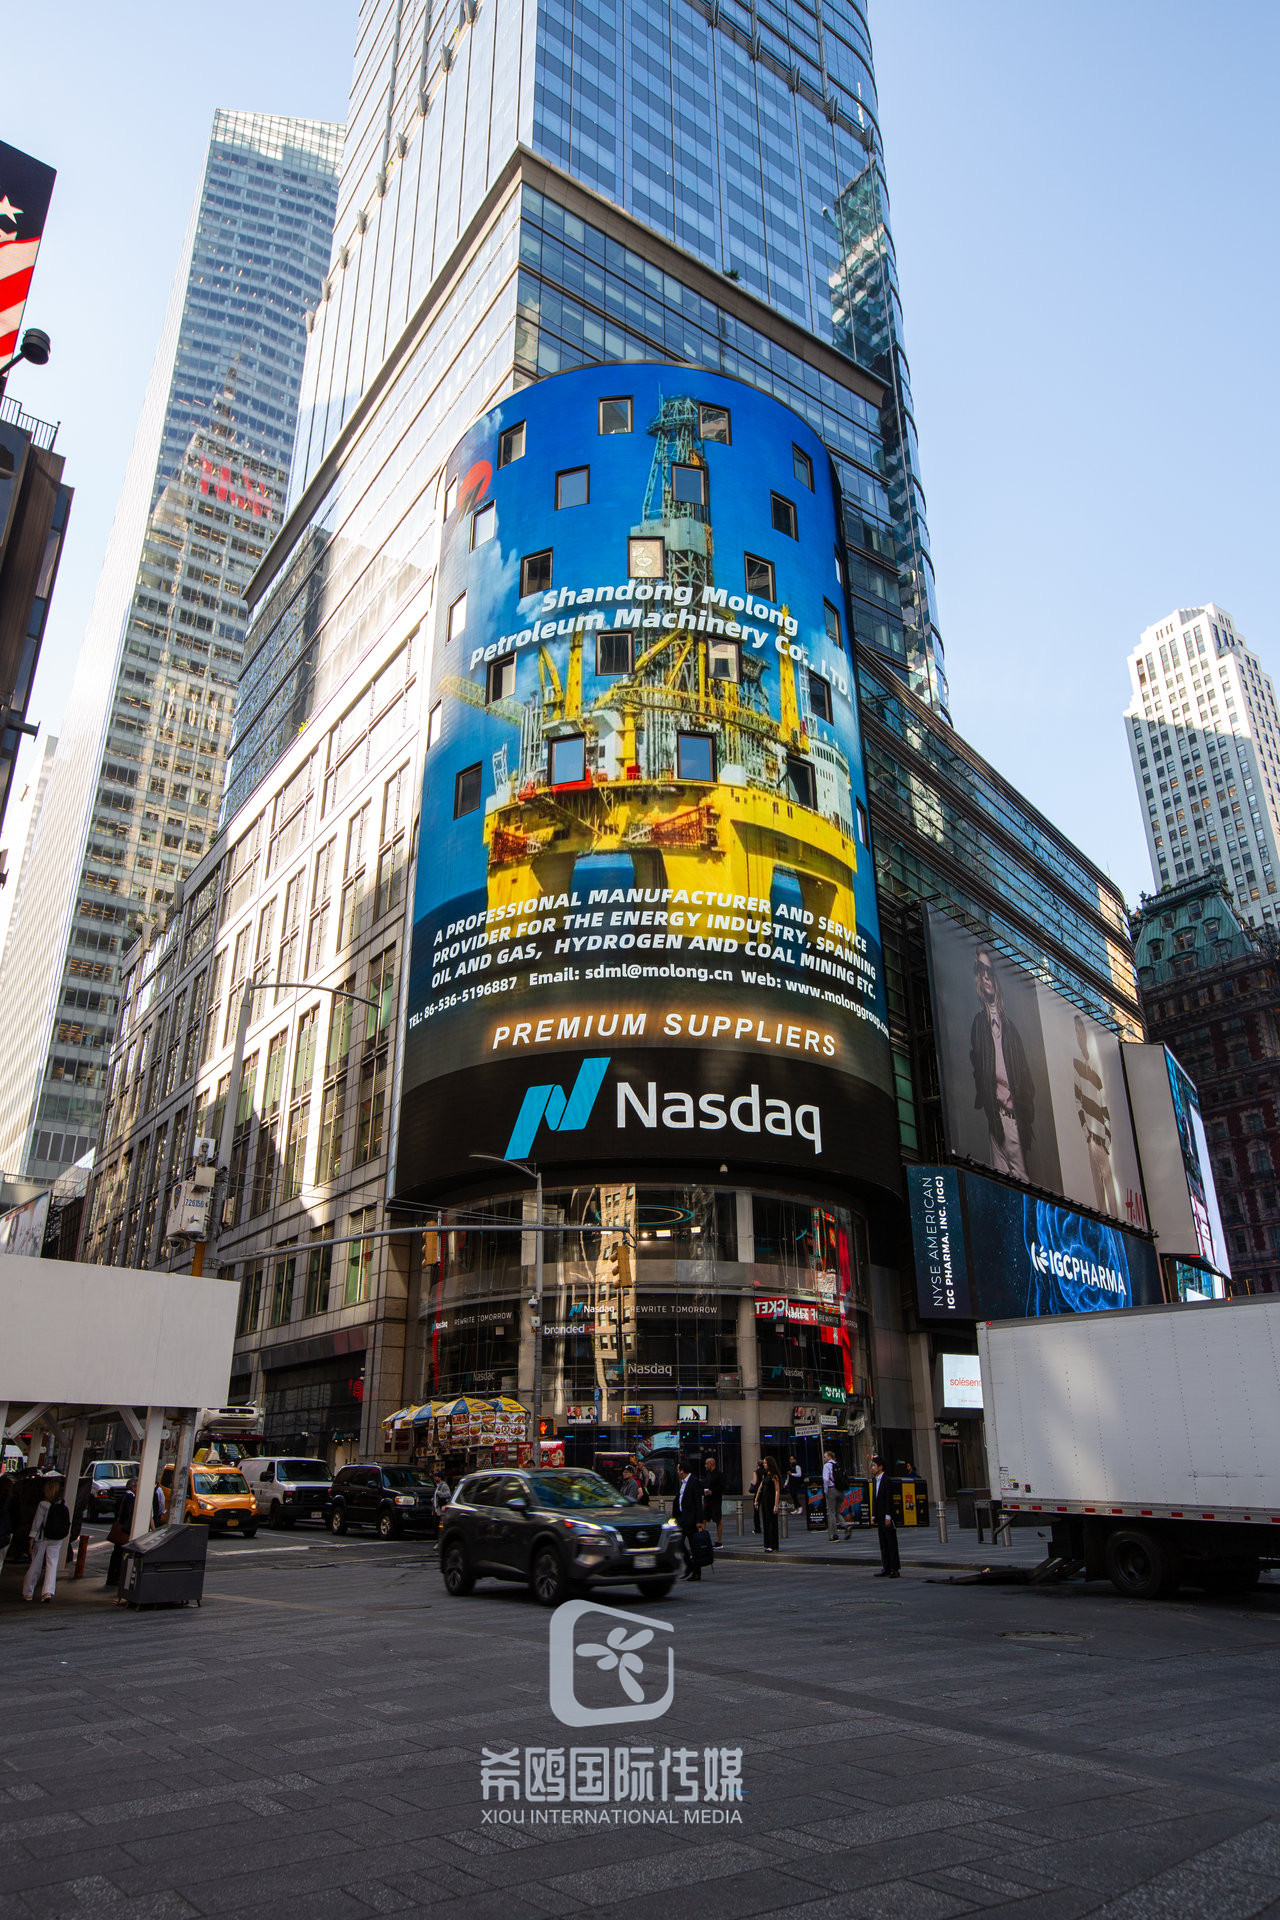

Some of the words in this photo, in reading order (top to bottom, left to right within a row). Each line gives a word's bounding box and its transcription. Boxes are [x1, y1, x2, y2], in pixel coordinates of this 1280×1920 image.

[541, 580, 693, 612] Shandong
[701, 586, 799, 637] Molong
[469, 613, 604, 671] Petroleum
[613, 608, 769, 649] Machinery
[821, 659, 852, 702] LTD.
[432, 929, 511, 967] PROVIDER
[516, 917, 556, 938] FOR
[563, 912, 604, 930] THE
[609, 911, 701, 927] ENERGY
[707, 914, 811, 949] INDUSTRY,
[816, 937, 876, 980] SPANNING
[433, 930, 443, 947] A
[446, 892, 582, 940] PROFESSIONAL
[588, 888, 771, 914] MANUFACTURER
[775, 903, 814, 925] AND
[818, 916, 867, 953] SERVICE
[431, 967, 451, 989] OIL
[454, 953, 492, 978] AND
[497, 943, 543, 965] GAS,
[554, 933, 683, 954] HYDROGEN
[688, 936, 738, 953] AND
[744, 941, 795, 964] COAL
[800, 952, 855, 985] MINING
[856, 974, 876, 1000] ETC.
[409, 1012, 423, 1030] TEL:
[424, 976, 517, 1019] 86-536-5196887
[529, 967, 580, 986] Email:
[585, 963, 733, 982] sdml@molong.cn
[741, 970, 782, 988] Web:
[492, 1012, 647, 1050] PREMIUM
[663, 1013, 836, 1057] SUPPLIERS
[617, 1082, 822, 1155] Nasdaq
[935, 1176, 946, 1203] (IGC)
[922, 1177, 940, 1260] AMERICAN
[938, 1206, 948, 1229] INC.
[930, 1266, 944, 1306] NYSE
[941, 1232, 954, 1286] PHARMA,
[477, 1312, 512, 1322] TOMORROW
[583, 1305, 615, 1314] Nasdaq
[631, 1305, 667, 1313] REWRITE
[670, 1305, 718, 1314] TOMORROW
[946, 1289, 956, 1310] IGC
[628, 1363, 672, 1377] Nasdaq
